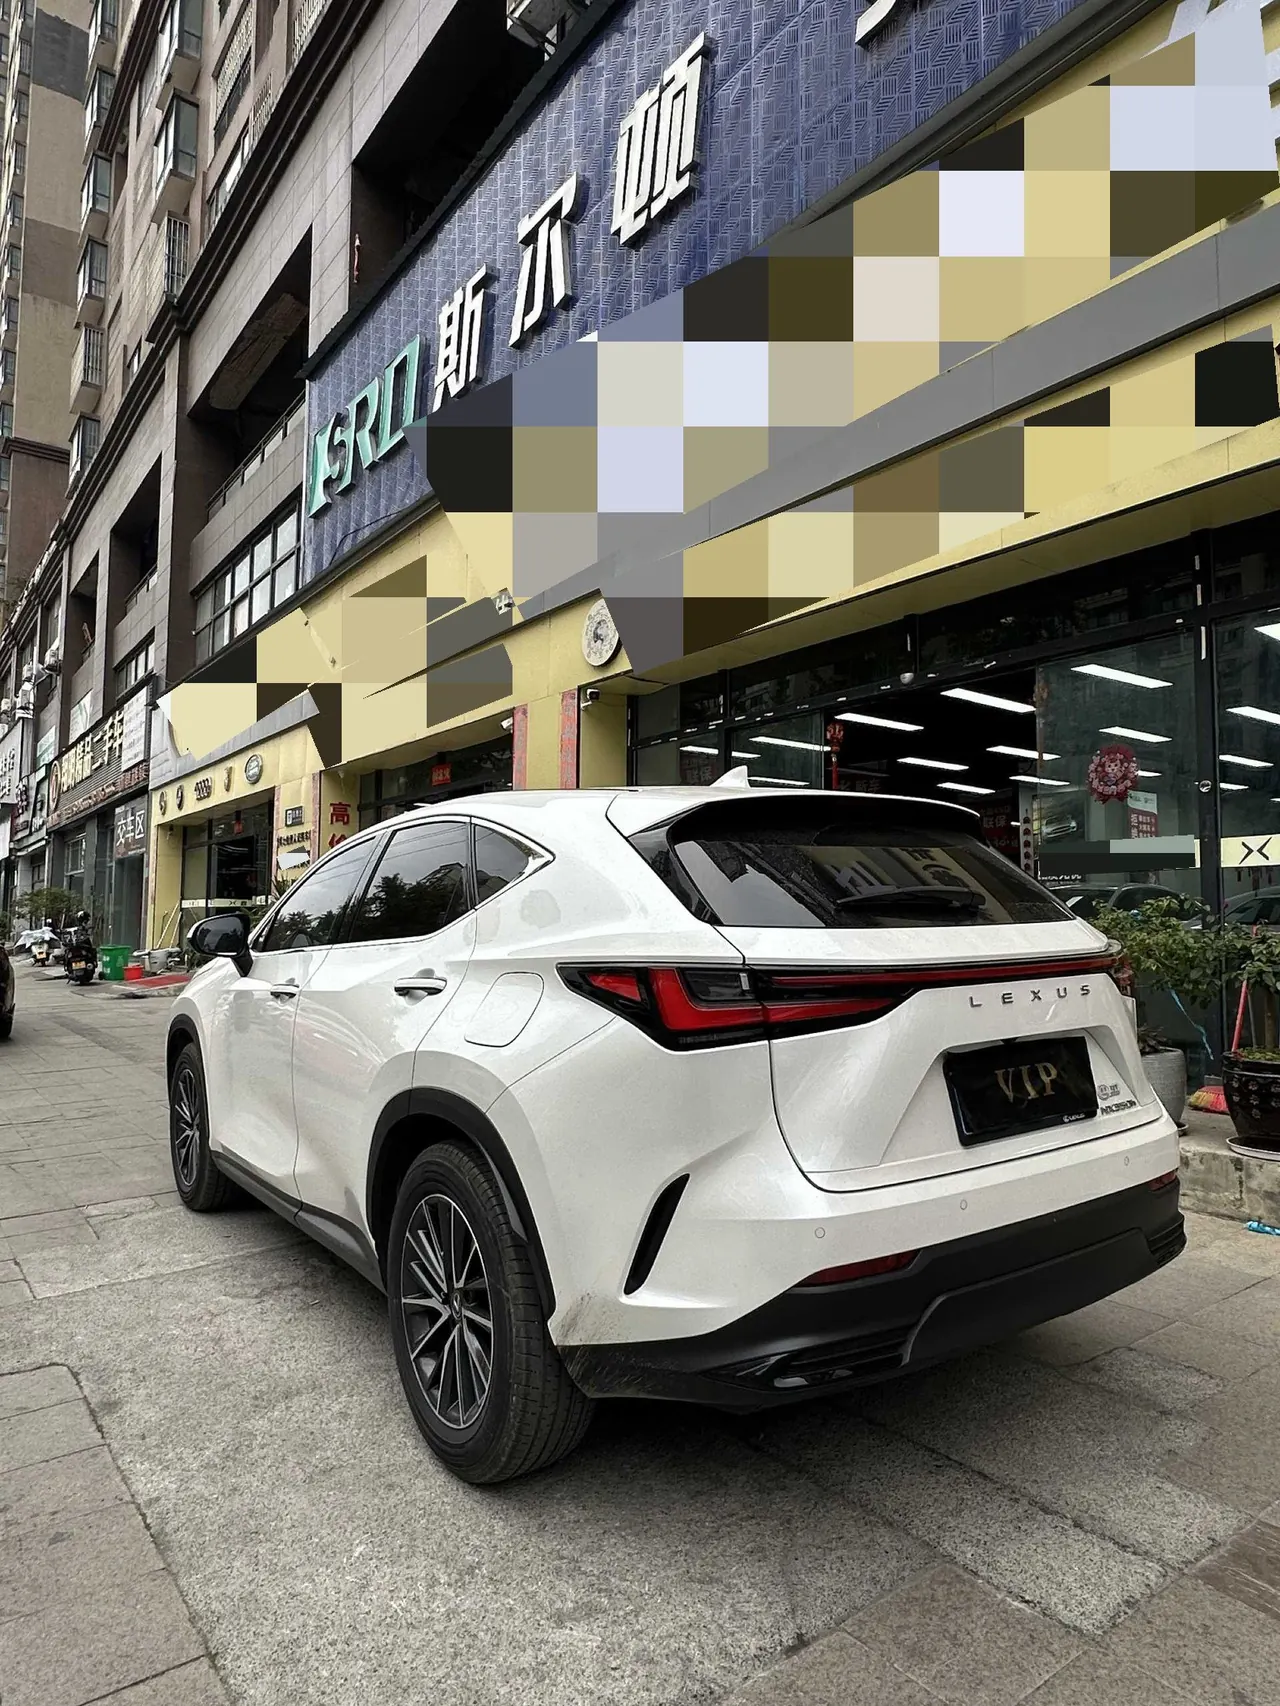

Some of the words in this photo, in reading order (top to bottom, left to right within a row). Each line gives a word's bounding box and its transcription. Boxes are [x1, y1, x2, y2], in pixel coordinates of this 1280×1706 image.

[115, 809, 146, 847] 交车区
[968, 984, 1091, 1008] LEXUS
[994, 1062, 1058, 1103] VIP
